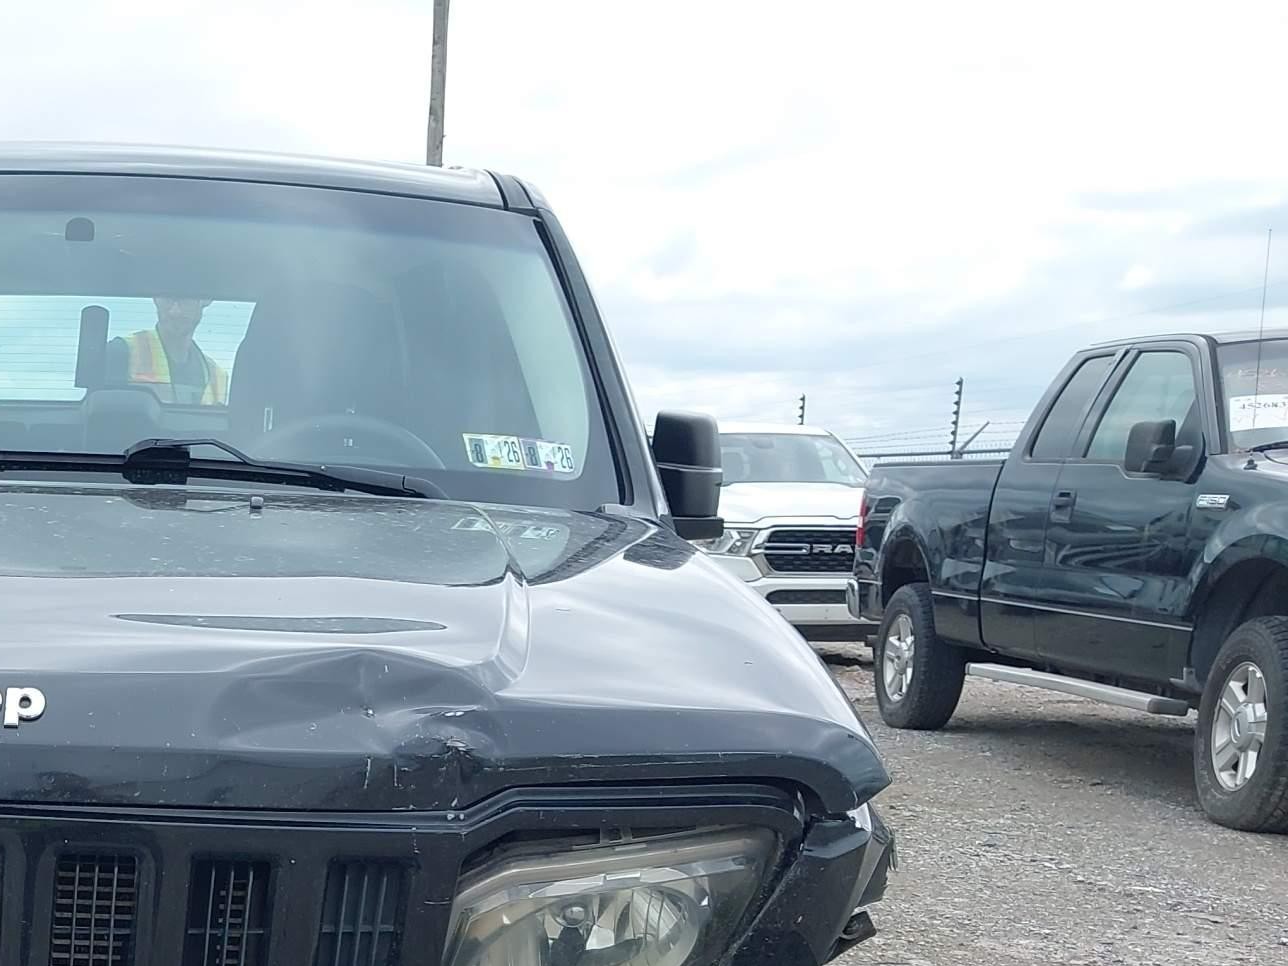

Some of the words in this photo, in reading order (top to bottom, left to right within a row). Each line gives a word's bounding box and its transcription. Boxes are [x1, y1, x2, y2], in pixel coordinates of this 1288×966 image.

[504, 440, 521, 463] 26
[558, 446, 574, 470] 26
[812, 543, 855, 554] RA
